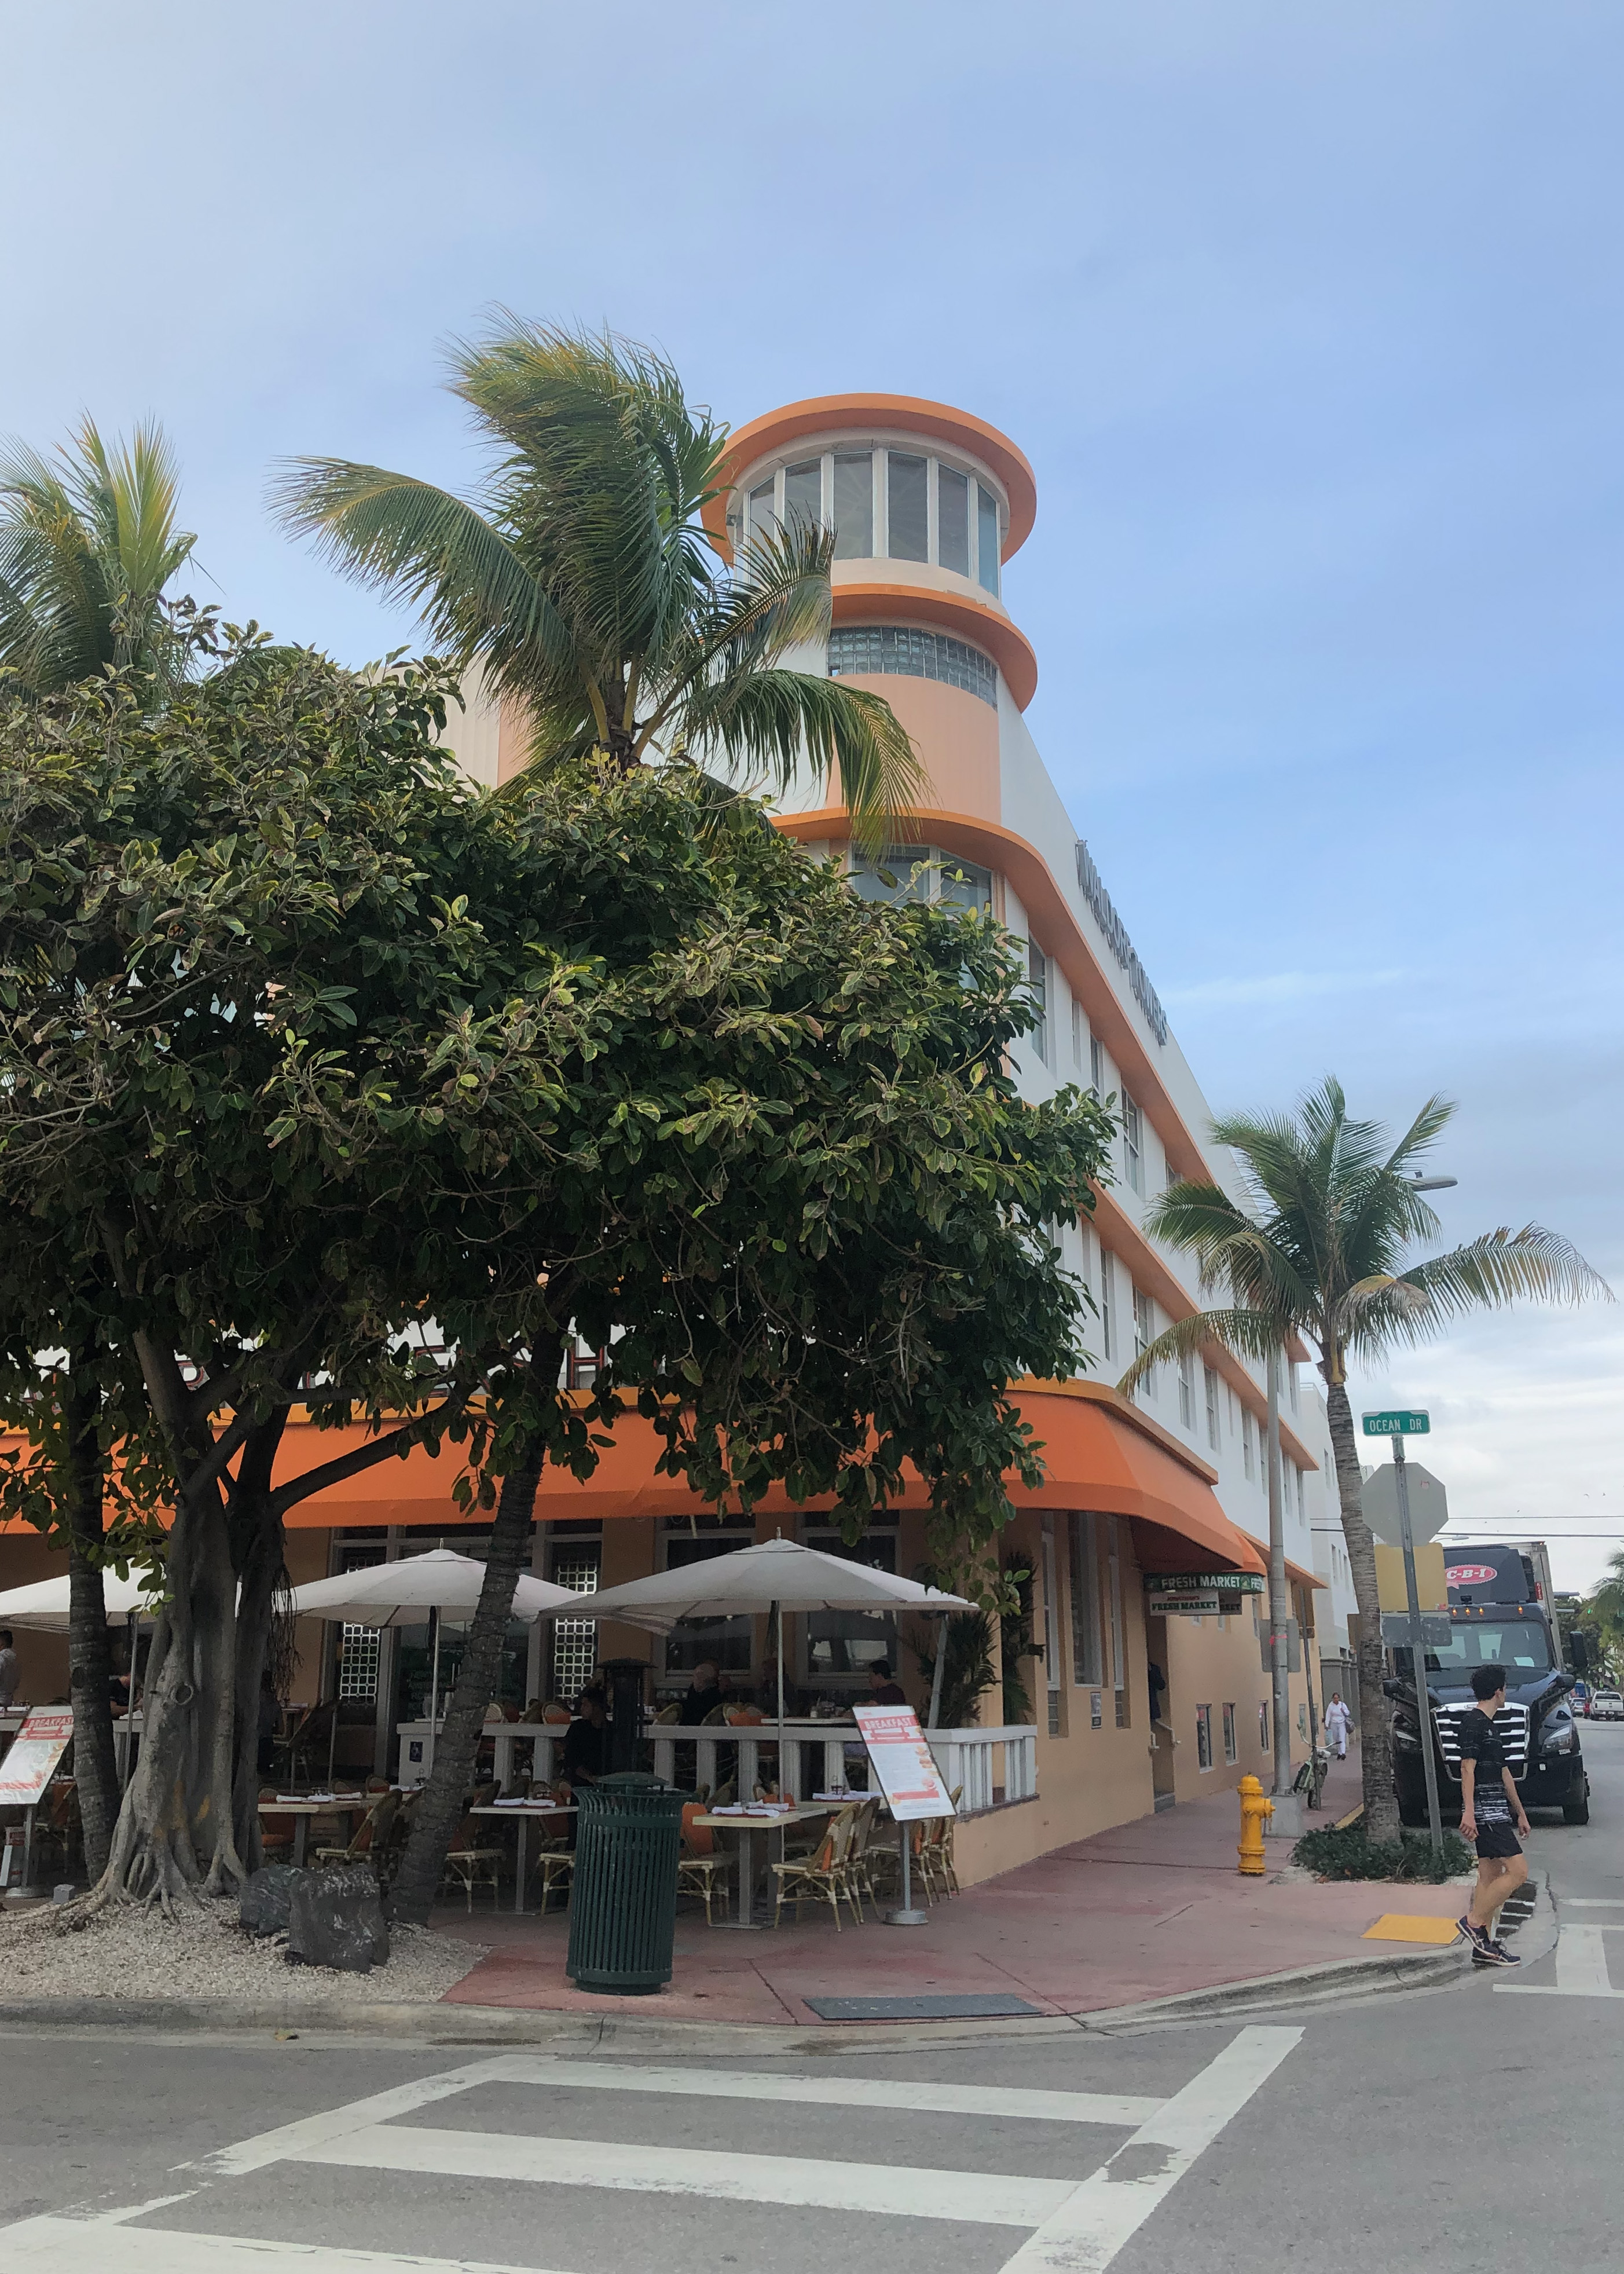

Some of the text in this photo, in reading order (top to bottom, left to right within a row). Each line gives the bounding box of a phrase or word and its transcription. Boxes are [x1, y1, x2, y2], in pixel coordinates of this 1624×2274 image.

[1075, 840, 1167, 1046] WALDORF TOWERS
[1369, 1418, 1423, 1432] OCEAN DR
[1161, 1576, 1197, 1589] FRESH
[1200, 1576, 1241, 1588] MARKET
[1151, 1601, 1218, 1611] FRESH MARKET
[864, 1717, 912, 1730] BREAKFAST
